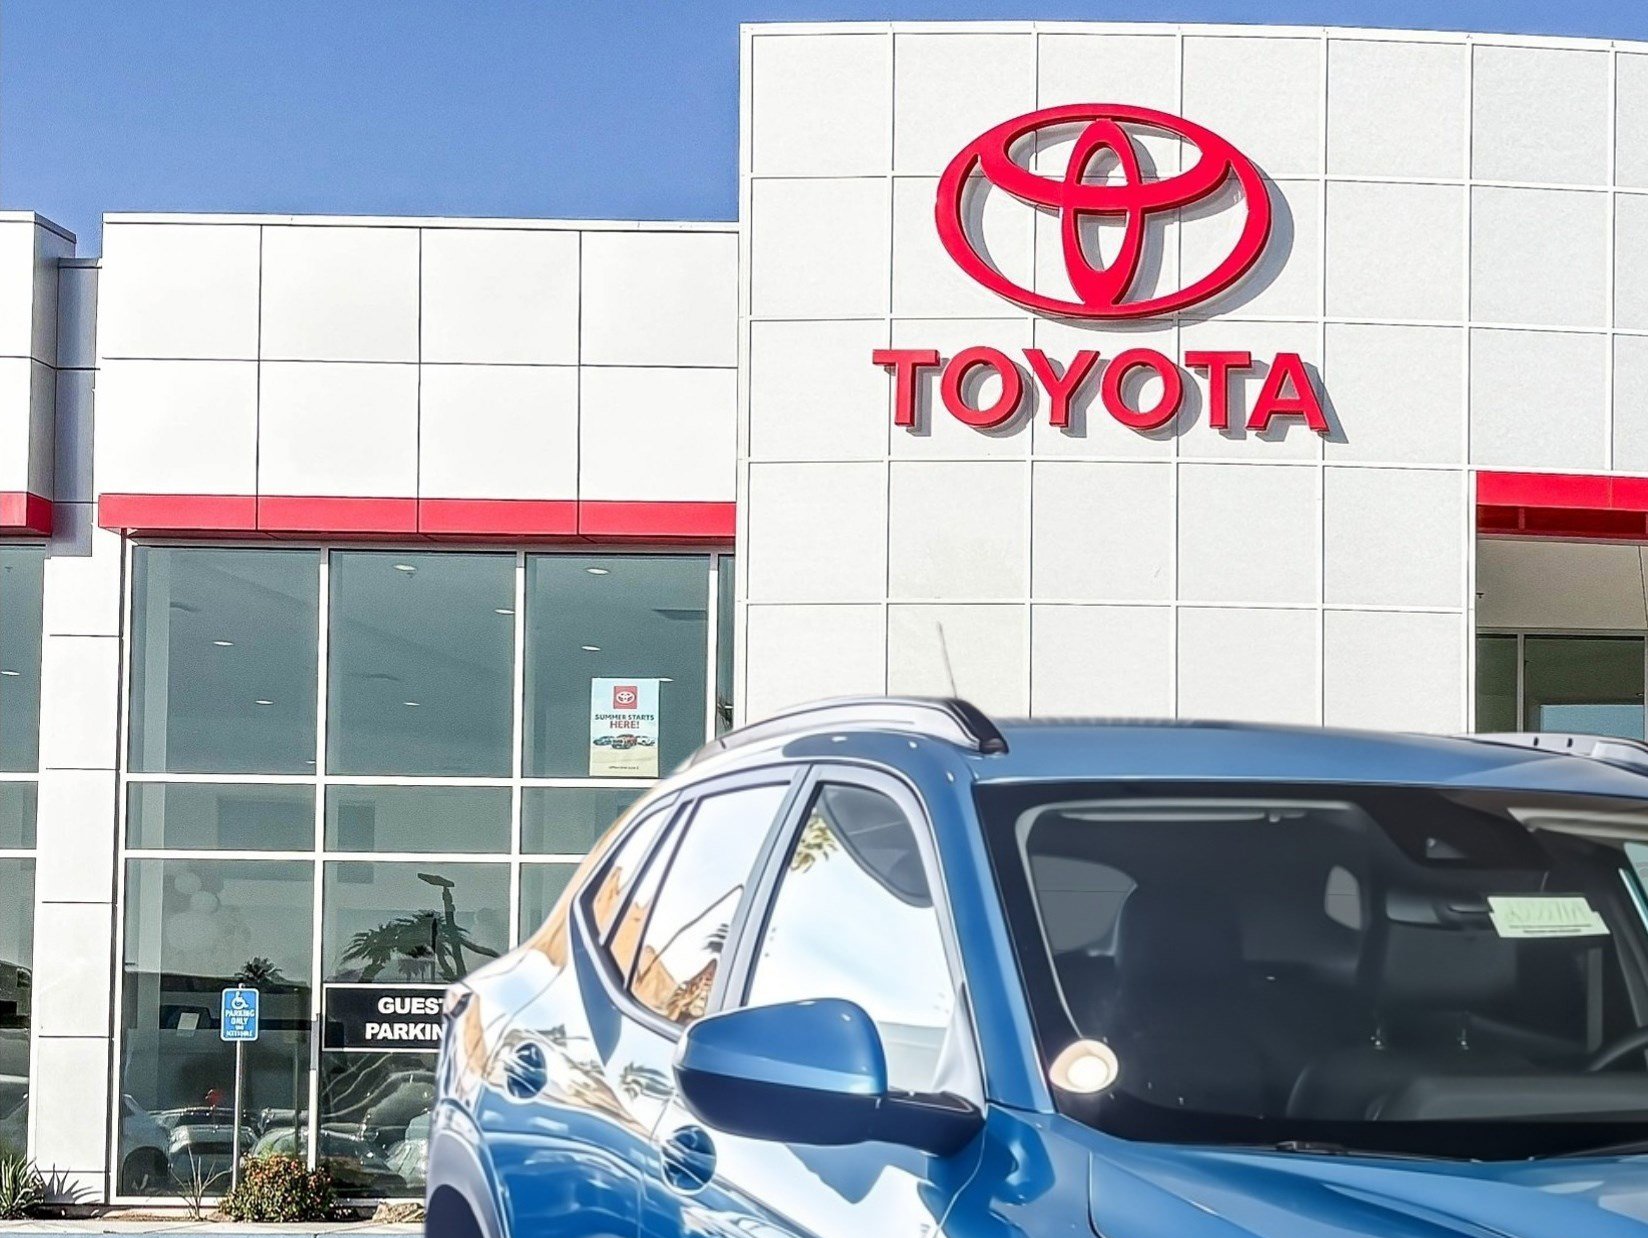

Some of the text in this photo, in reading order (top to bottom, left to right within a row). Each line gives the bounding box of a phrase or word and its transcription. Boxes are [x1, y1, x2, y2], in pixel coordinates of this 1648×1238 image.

[872, 346, 1330, 433] TOYOTA
[609, 720, 640, 729] HERE!
[377, 997, 443, 1015] GUES
[365, 1022, 445, 1040] PARKIN
